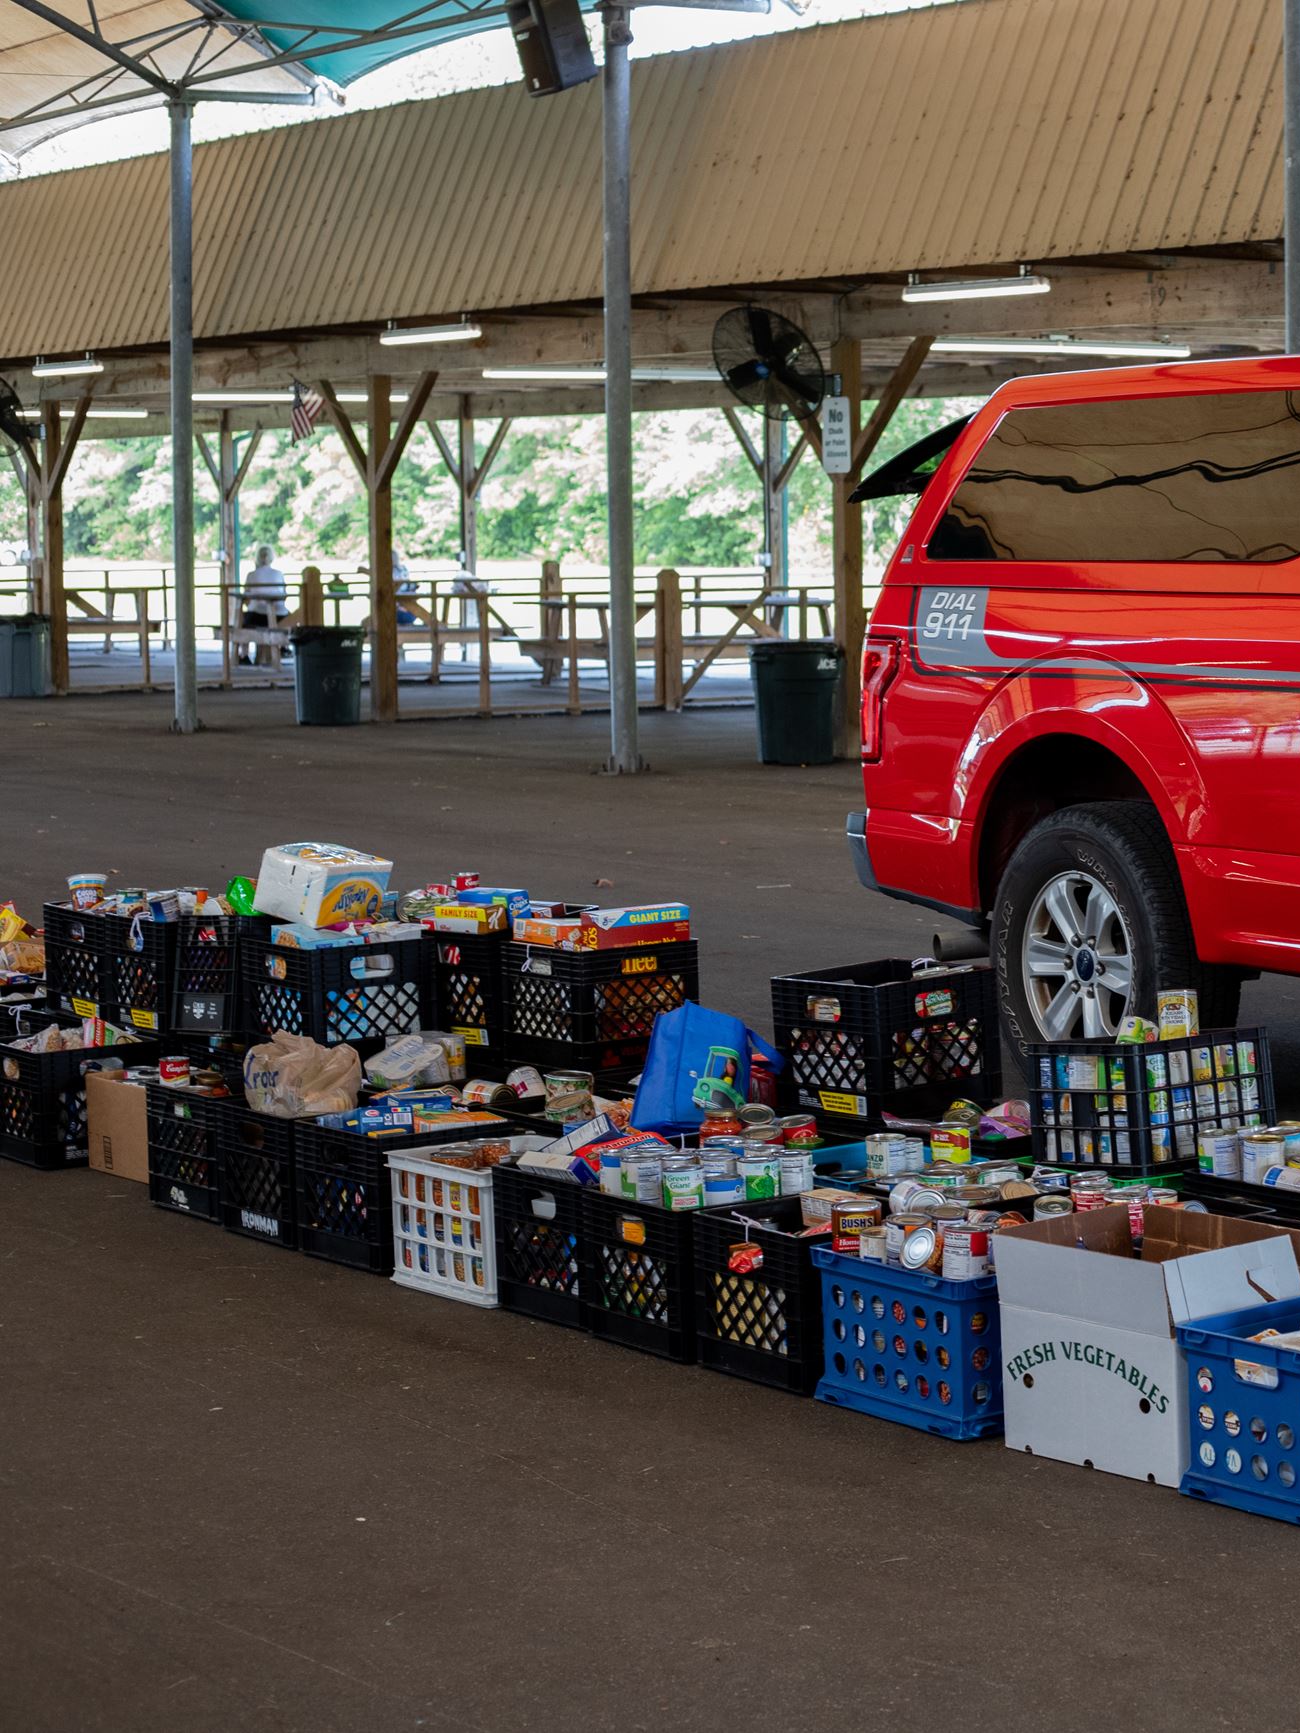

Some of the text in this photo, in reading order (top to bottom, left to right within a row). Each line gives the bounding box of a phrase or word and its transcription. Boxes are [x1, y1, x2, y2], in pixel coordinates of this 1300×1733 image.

[828, 408, 843, 423] No
[930, 591, 977, 611] DIAL
[922, 612, 973, 640] 911
[817, 658, 837, 670] ACE
[440, 908, 478, 919] FAMILY SIZE
[629, 909, 681, 923] GIANT SIZE
[601, 1134, 652, 1149] Maruchan
[1006, 1341, 1170, 1414] FRESH VEGETABLES
